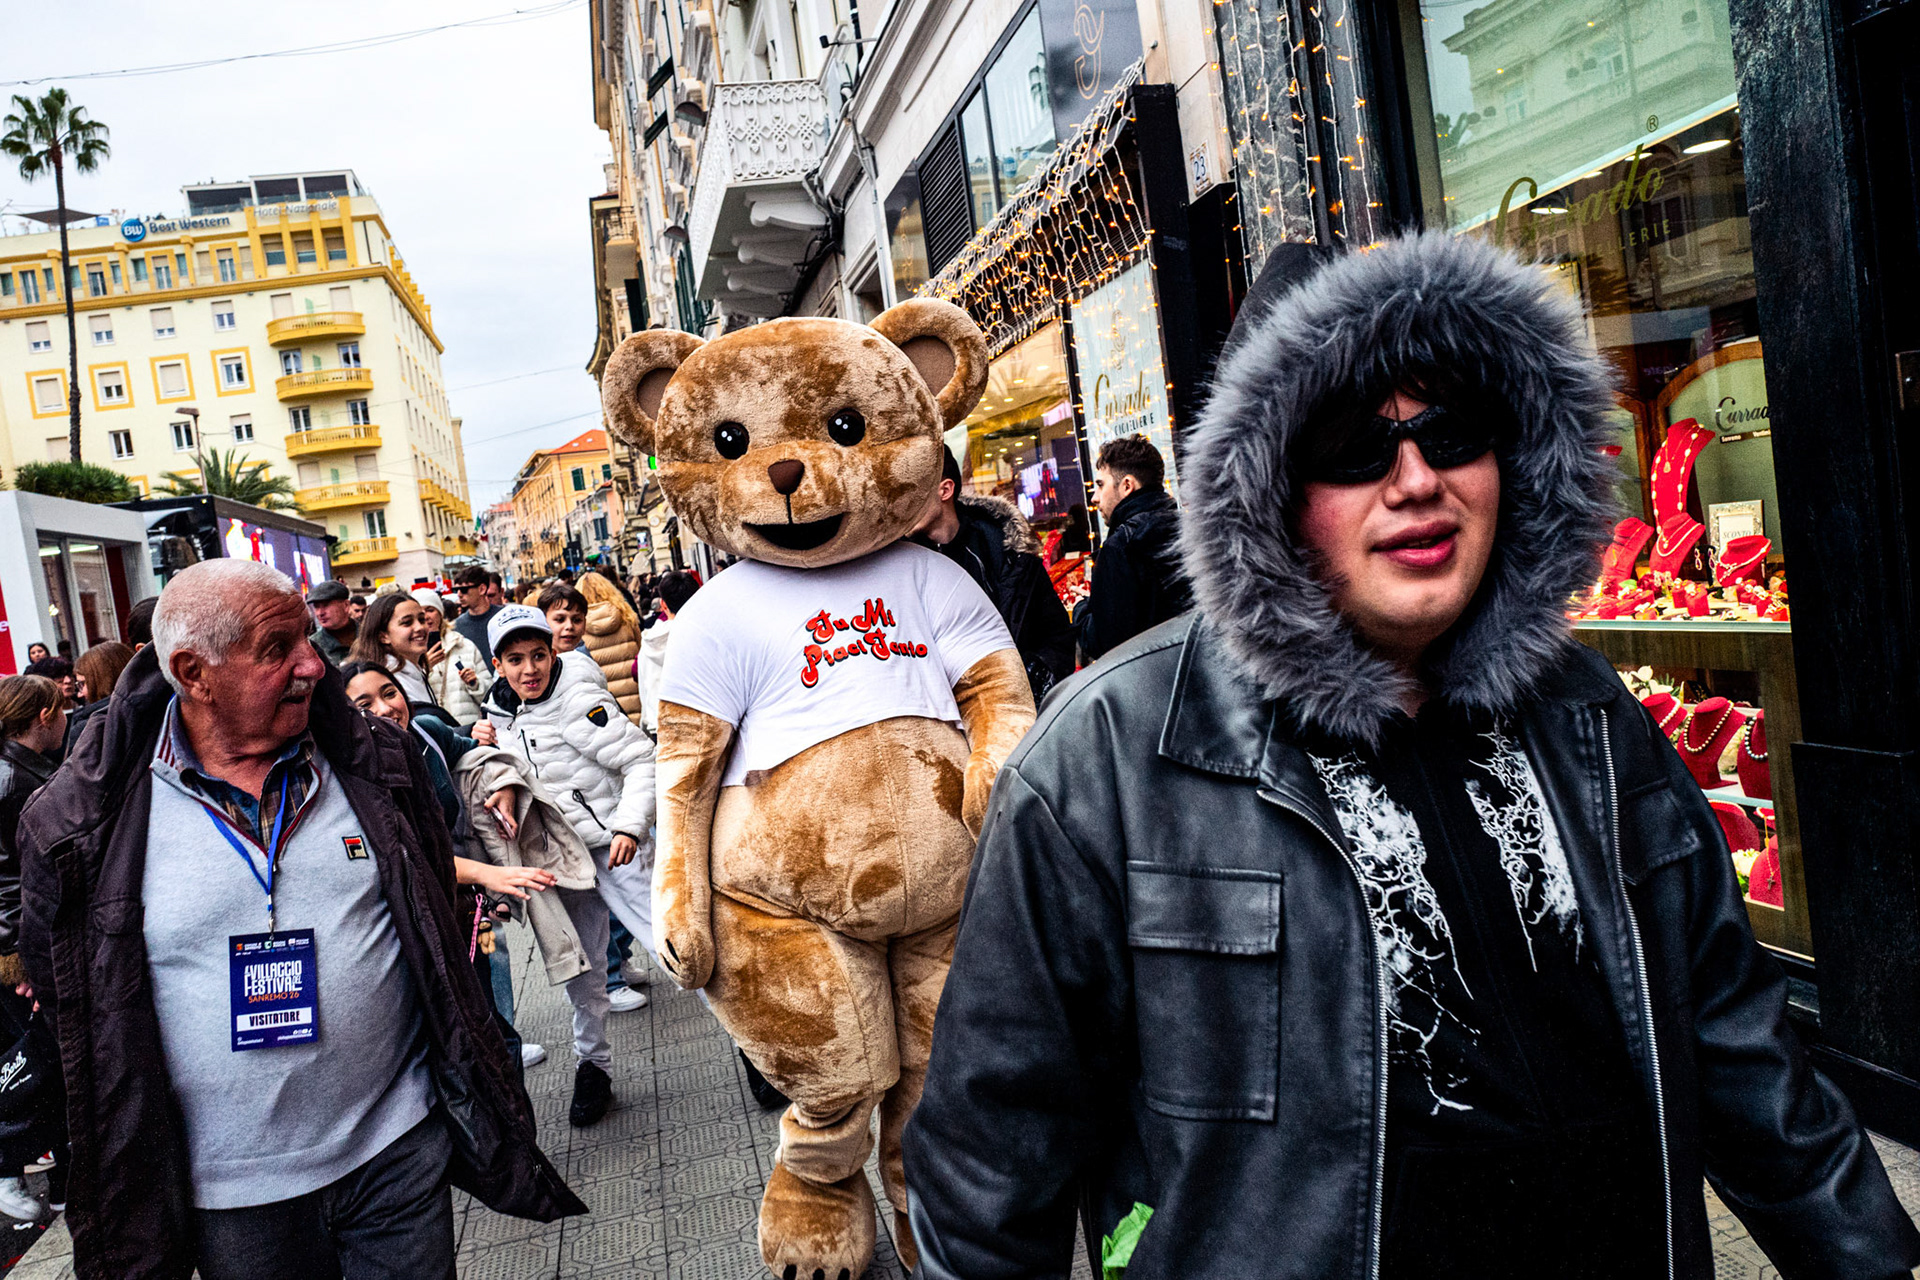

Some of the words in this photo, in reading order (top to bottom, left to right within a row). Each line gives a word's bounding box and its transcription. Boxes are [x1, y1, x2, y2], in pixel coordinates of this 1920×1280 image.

[1193, 155, 1207, 181] 23
[253, 205, 282, 218] Hotel
[286, 200, 338, 215] Nazionale
[124, 225, 143, 237] BW
[149, 221, 177, 234] Best
[179, 217, 230, 231] Western
[805, 609, 850, 644] Tu
[850, 597, 896, 633] Mi
[800, 639, 868, 689] Piaci
[863, 627, 928, 661] Tanto
[244, 975, 303, 997] FESTIVAL
[248, 991, 288, 1004] SANREMO
[289, 991, 300, 1000] 26
[249, 1010, 300, 1027] VISITATORE
